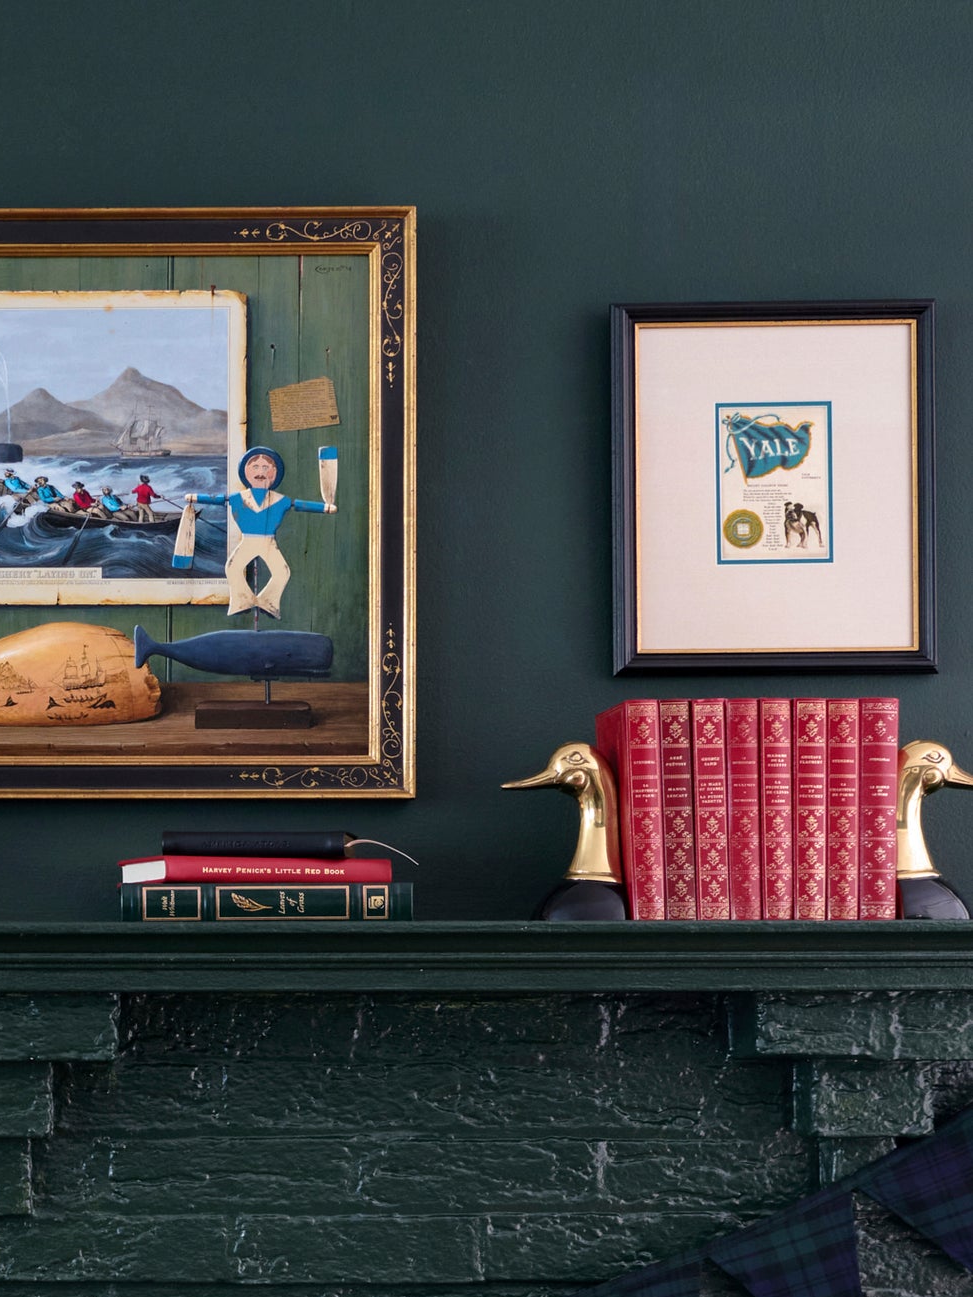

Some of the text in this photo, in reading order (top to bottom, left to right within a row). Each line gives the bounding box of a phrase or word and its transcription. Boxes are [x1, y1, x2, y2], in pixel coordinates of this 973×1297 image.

[738, 436, 801, 461] YALE
[202, 866, 232, 874] HARVEY
[235, 866, 272, 874] PENICK'S
[275, 867, 302, 875] LITTLE
[305, 867, 321, 875] RED
[278, 890, 286, 915] Leaves
[286, 896, 298, 907] of
[297, 891, 305, 913] Grass
